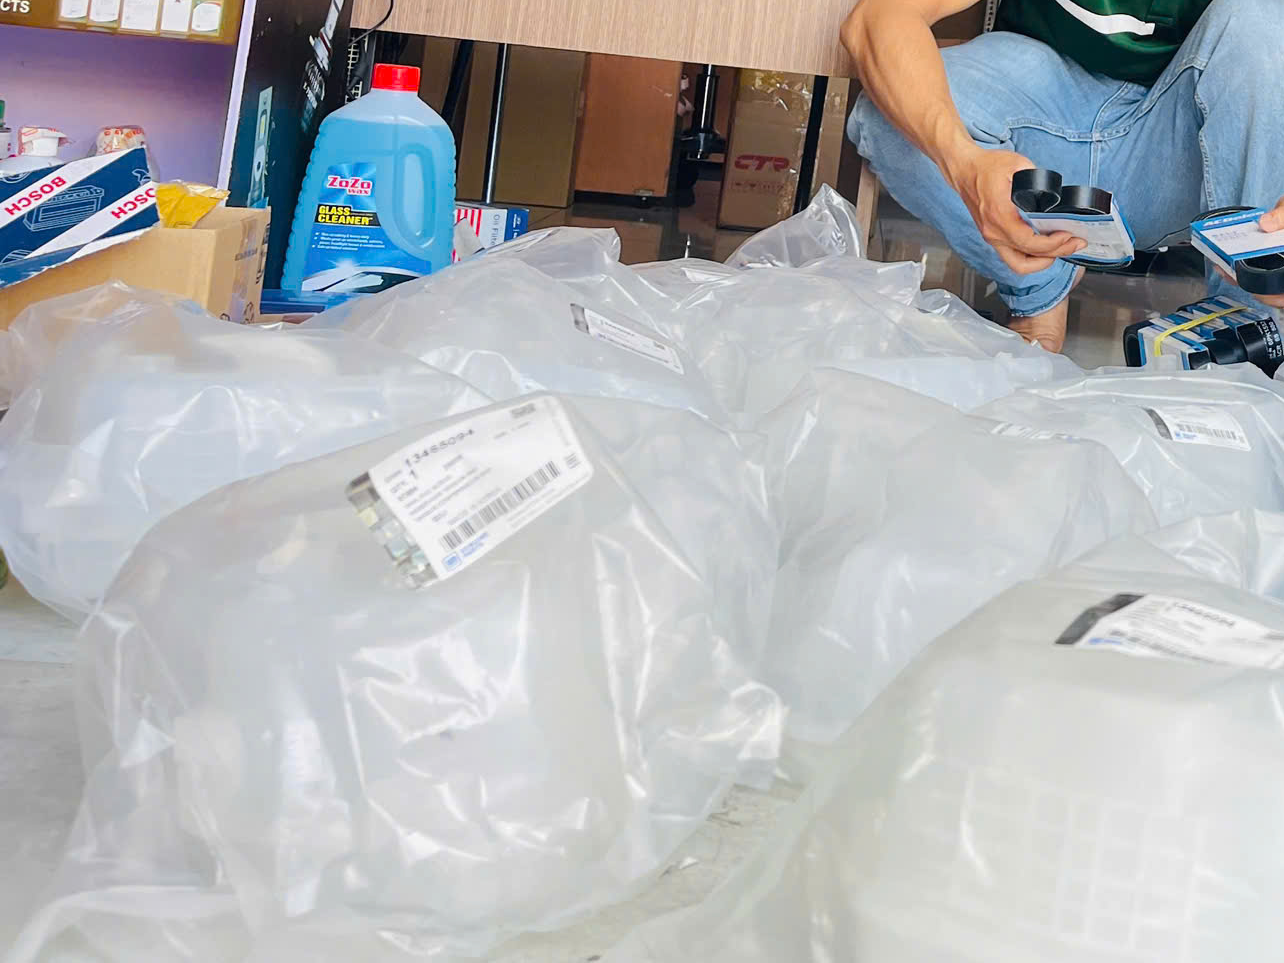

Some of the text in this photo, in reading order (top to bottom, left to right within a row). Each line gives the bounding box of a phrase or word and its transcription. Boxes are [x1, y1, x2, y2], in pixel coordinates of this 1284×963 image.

[327, 175, 372, 191] ZoZo
[4, 175, 67, 216] BOSCH
[347, 188, 371, 196] wax
[318, 205, 351, 217] GLASS
[317, 213, 371, 226] CLEANER
[490, 227, 499, 246] Filte
